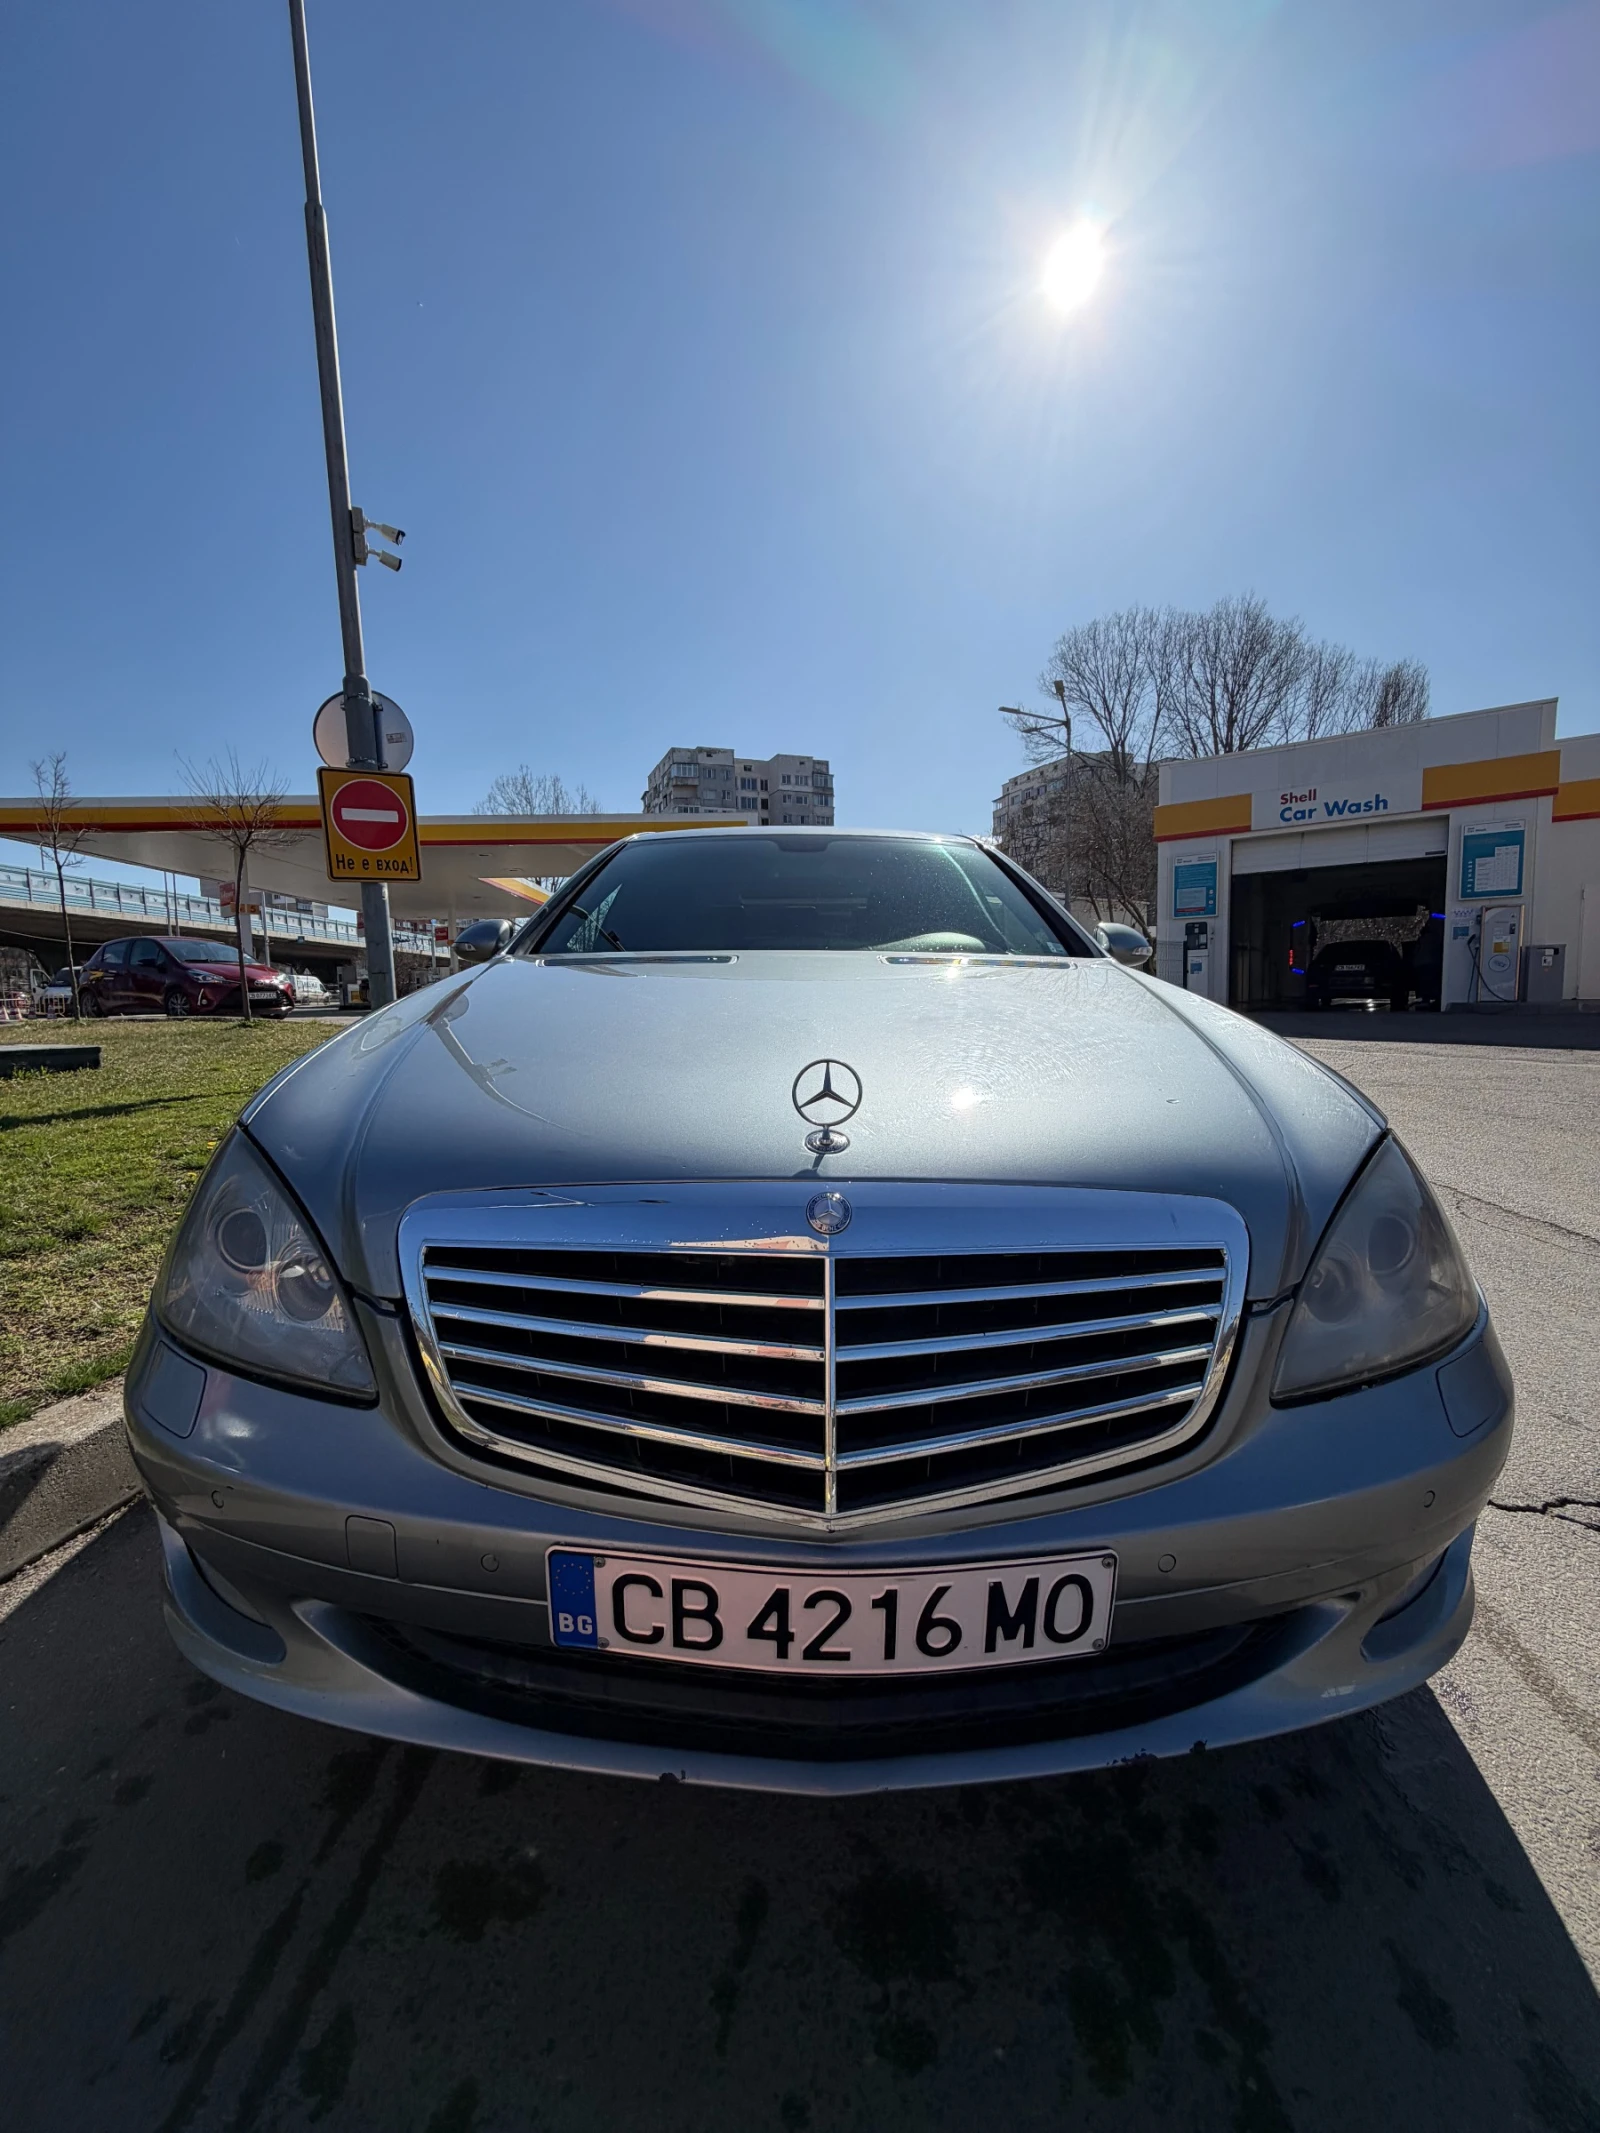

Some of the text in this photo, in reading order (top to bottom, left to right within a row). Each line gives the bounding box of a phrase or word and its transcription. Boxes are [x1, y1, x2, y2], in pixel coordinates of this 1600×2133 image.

[1279, 794, 1388, 822] Car Wash
[1280, 788, 1317, 805] Shell
[335, 854, 413, 874] Не е вход!
[558, 1612, 593, 1635] BG
[611, 1572, 1094, 1662] CB 4216 MO
